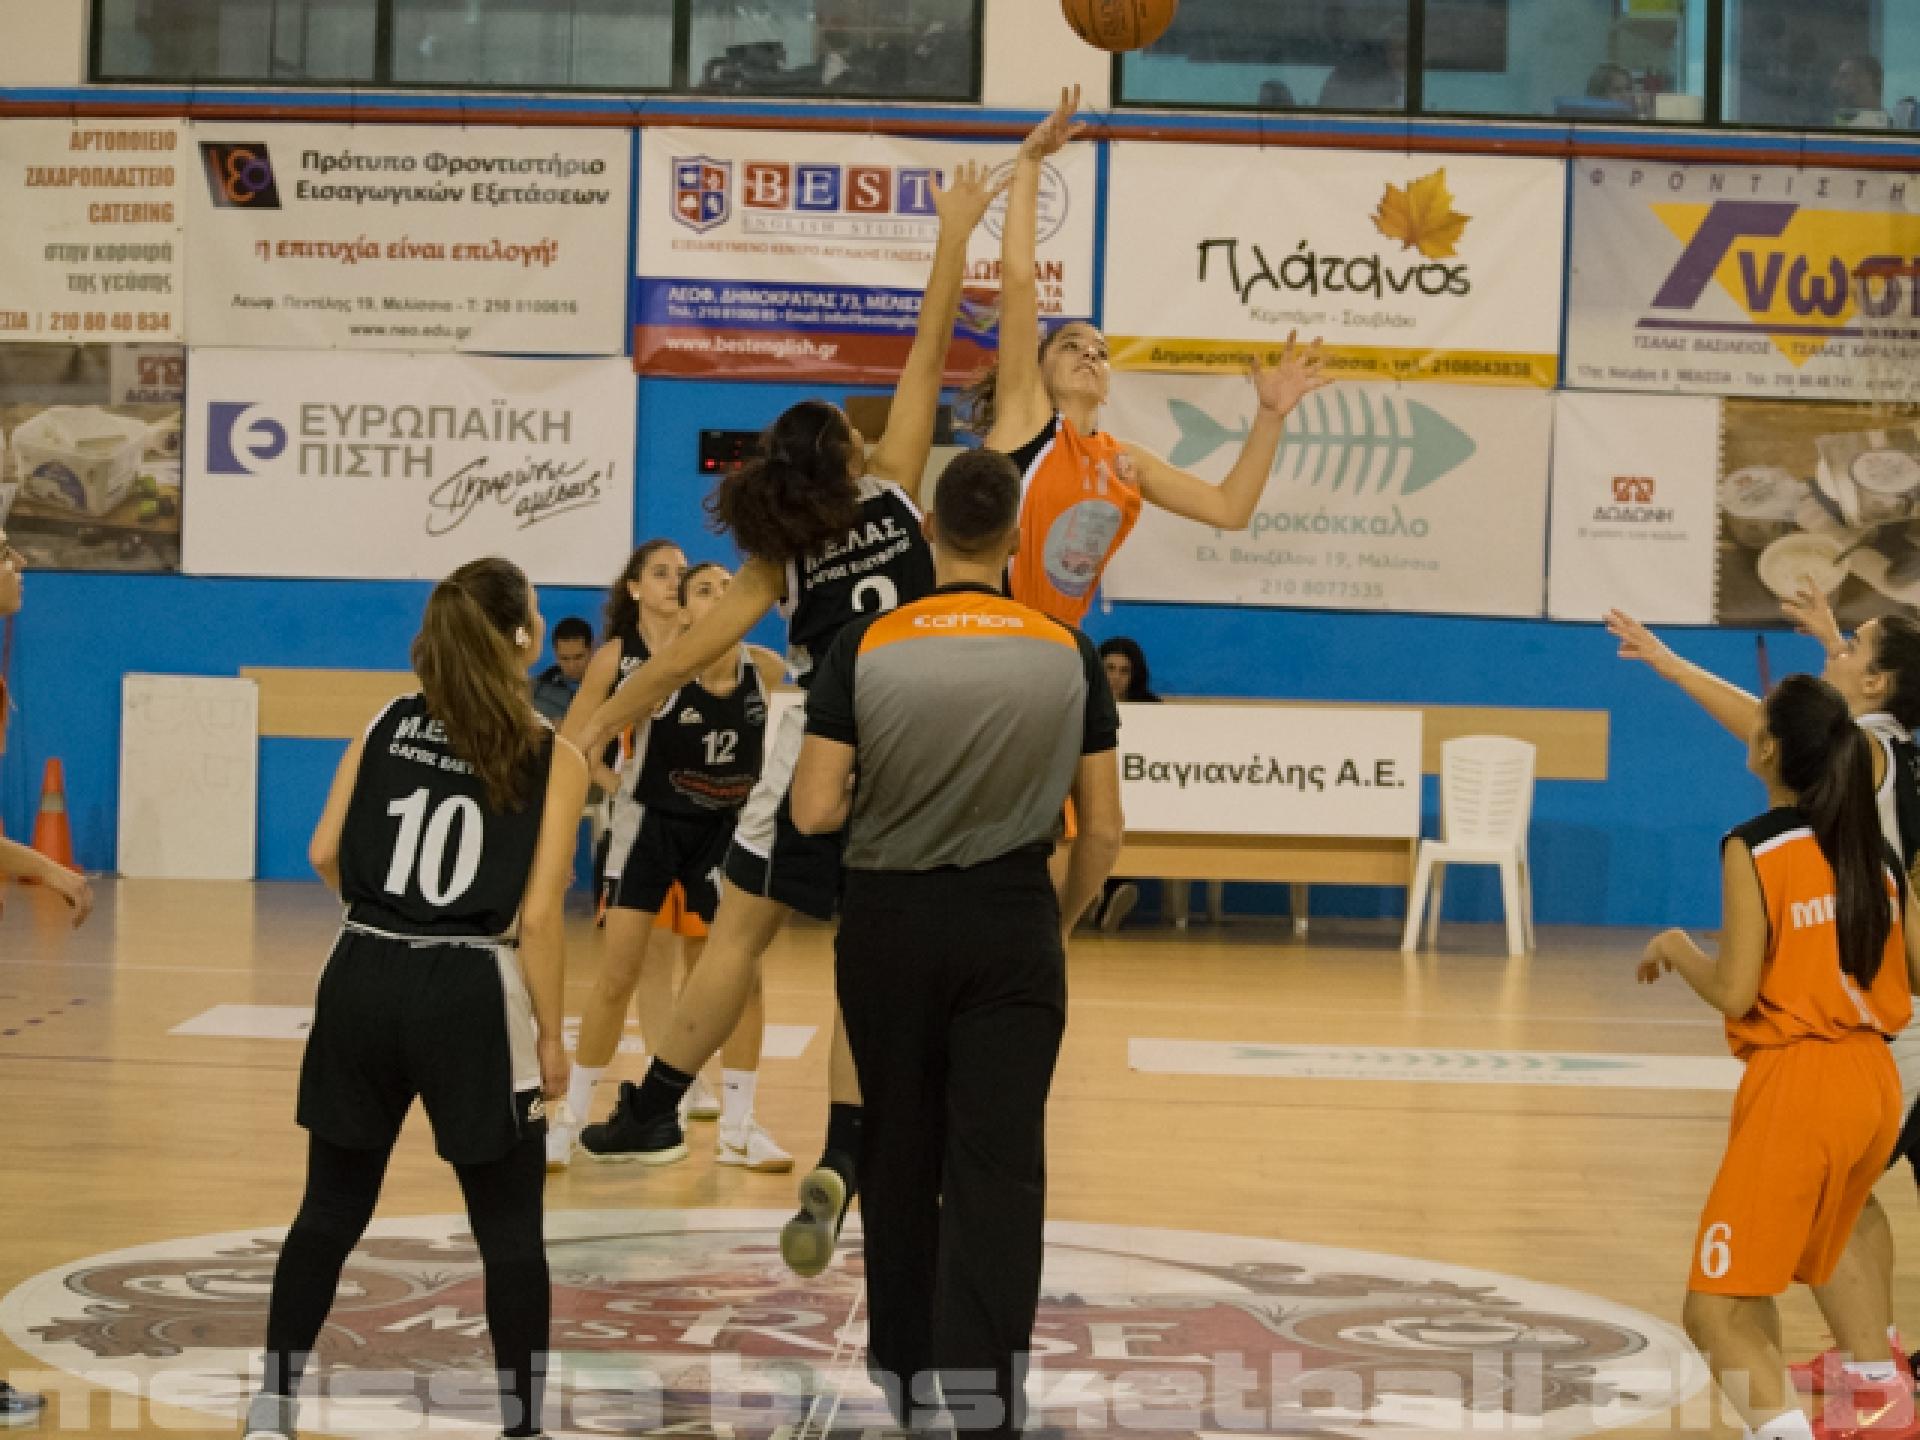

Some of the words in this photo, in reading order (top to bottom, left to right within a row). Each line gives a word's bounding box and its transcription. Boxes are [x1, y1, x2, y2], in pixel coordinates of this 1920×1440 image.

[302, 149, 418, 175] Πρότυπο
[424, 150, 606, 180] Φροντιστήριο
[296, 180, 465, 206] Εισαγωγικών
[471, 181, 611, 208] Εξετάσεων
[748, 163, 938, 214] BEST
[87, 202, 175, 225] CATERING
[255, 240, 270, 263] η
[275, 236, 380, 266] επιτυχία
[386, 237, 446, 260] είναι
[452, 238, 560, 269] επιλογή!
[1196, 236, 1472, 305] Πλάτανος
[666, 334, 839, 362] www.bestenglish.gr
[299, 399, 572, 445] ΕΥΡΩΠΑΪΚΗ
[298, 443, 434, 478] ΠΙΣΤΗ
[1213, 504, 1431, 541] ροκόκκαλο
[1260, 577, 1297, 597] 210
[702, 728, 740, 767] 12
[1122, 753, 1326, 792] Βαγιανέλης
[1335, 758, 1406, 789] Α.Ε.
[383, 786, 484, 907] 10
[1699, 1221, 1733, 1280] 6
